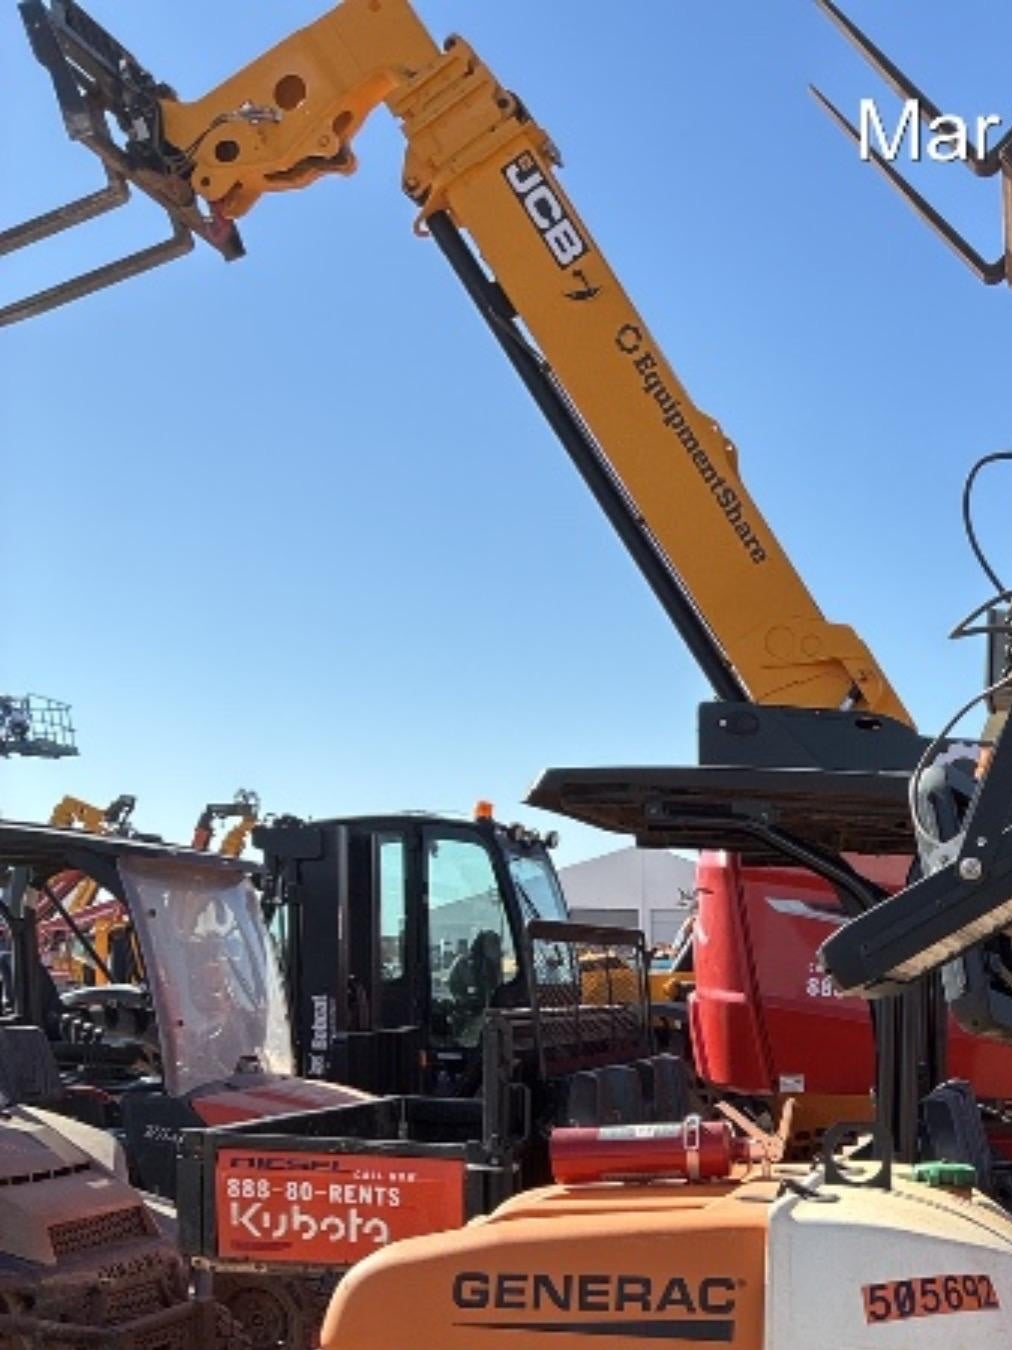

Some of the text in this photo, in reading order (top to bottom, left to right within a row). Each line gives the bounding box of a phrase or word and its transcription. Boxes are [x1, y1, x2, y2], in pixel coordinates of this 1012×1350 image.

[505, 163, 584, 266] JCB
[633, 351, 767, 565] EquipmentShare
[227, 1178, 401, 1207] 888-80-RENTS
[230, 1201, 389, 1245] Kubota
[452, 1272, 736, 1315] GENERAC
[868, 1275, 1000, 1321] 505692
